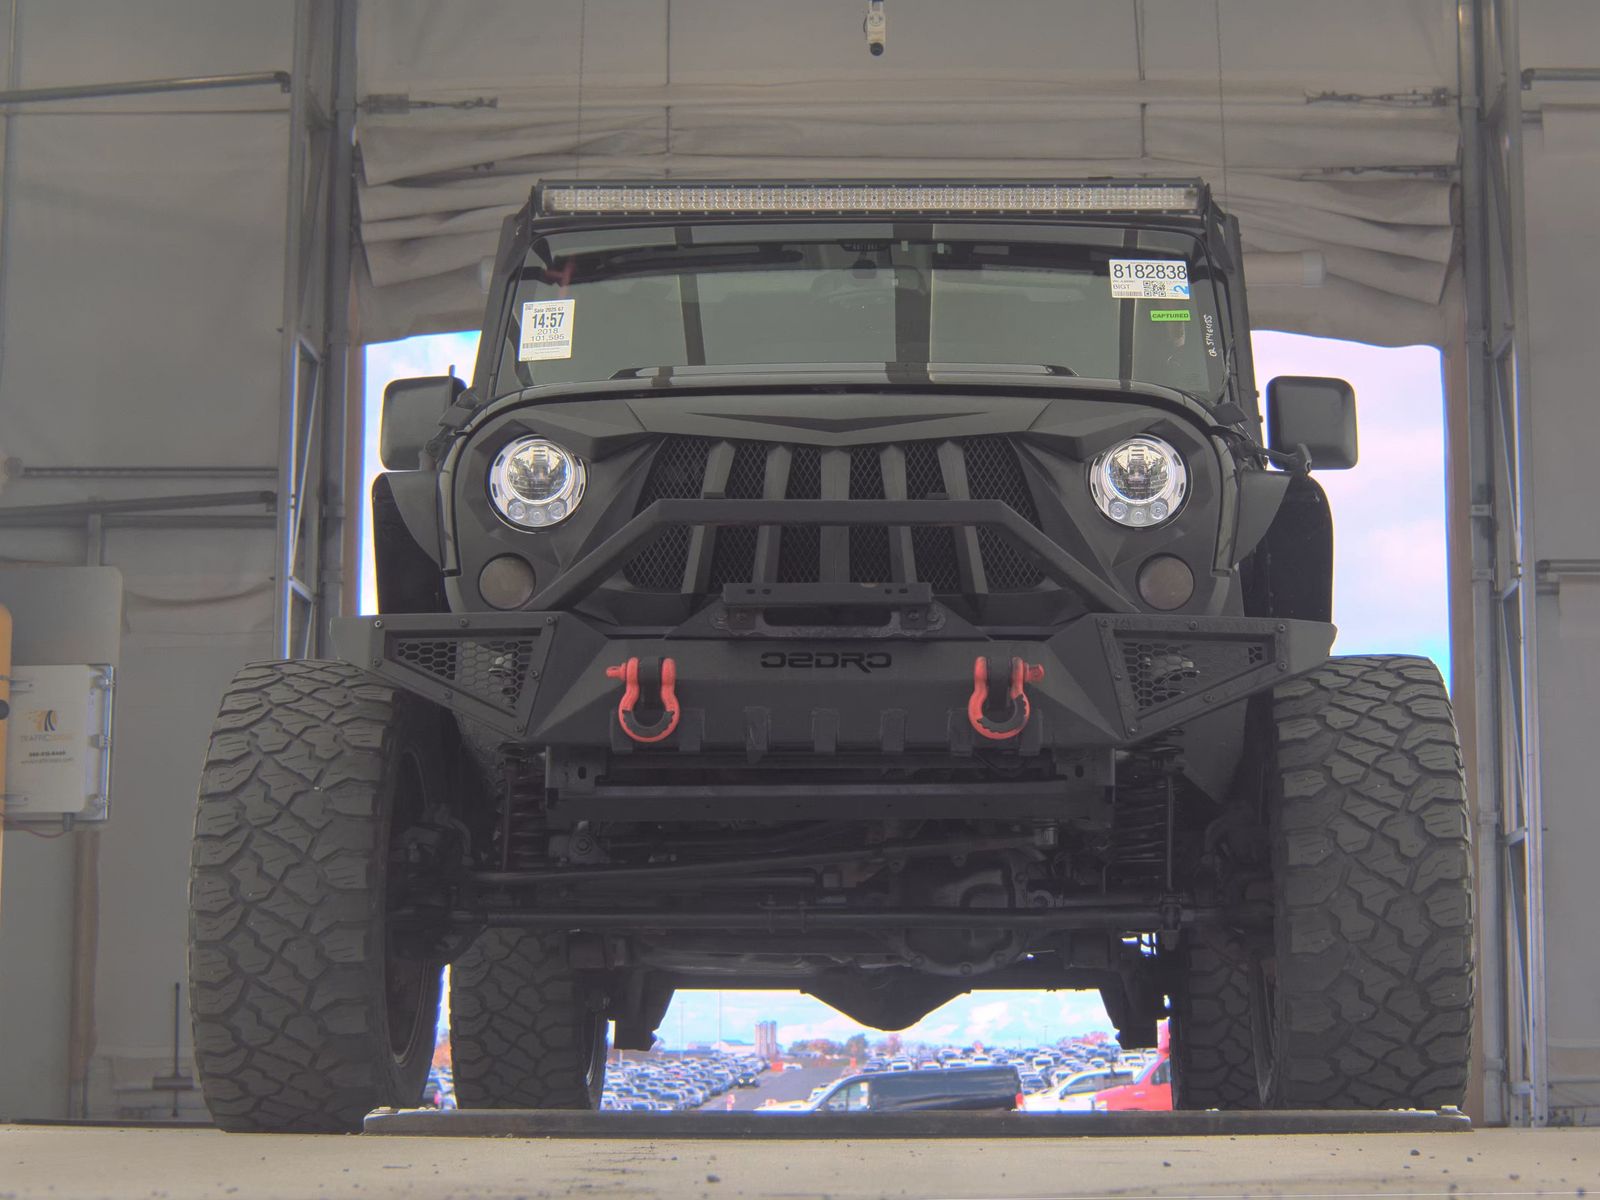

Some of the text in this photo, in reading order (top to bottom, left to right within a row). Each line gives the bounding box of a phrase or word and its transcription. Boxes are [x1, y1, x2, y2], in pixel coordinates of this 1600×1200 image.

[1113, 263, 1187, 280] 8182838
[532, 312, 565, 329] 14:57
[537, 328, 559, 336] 2018
